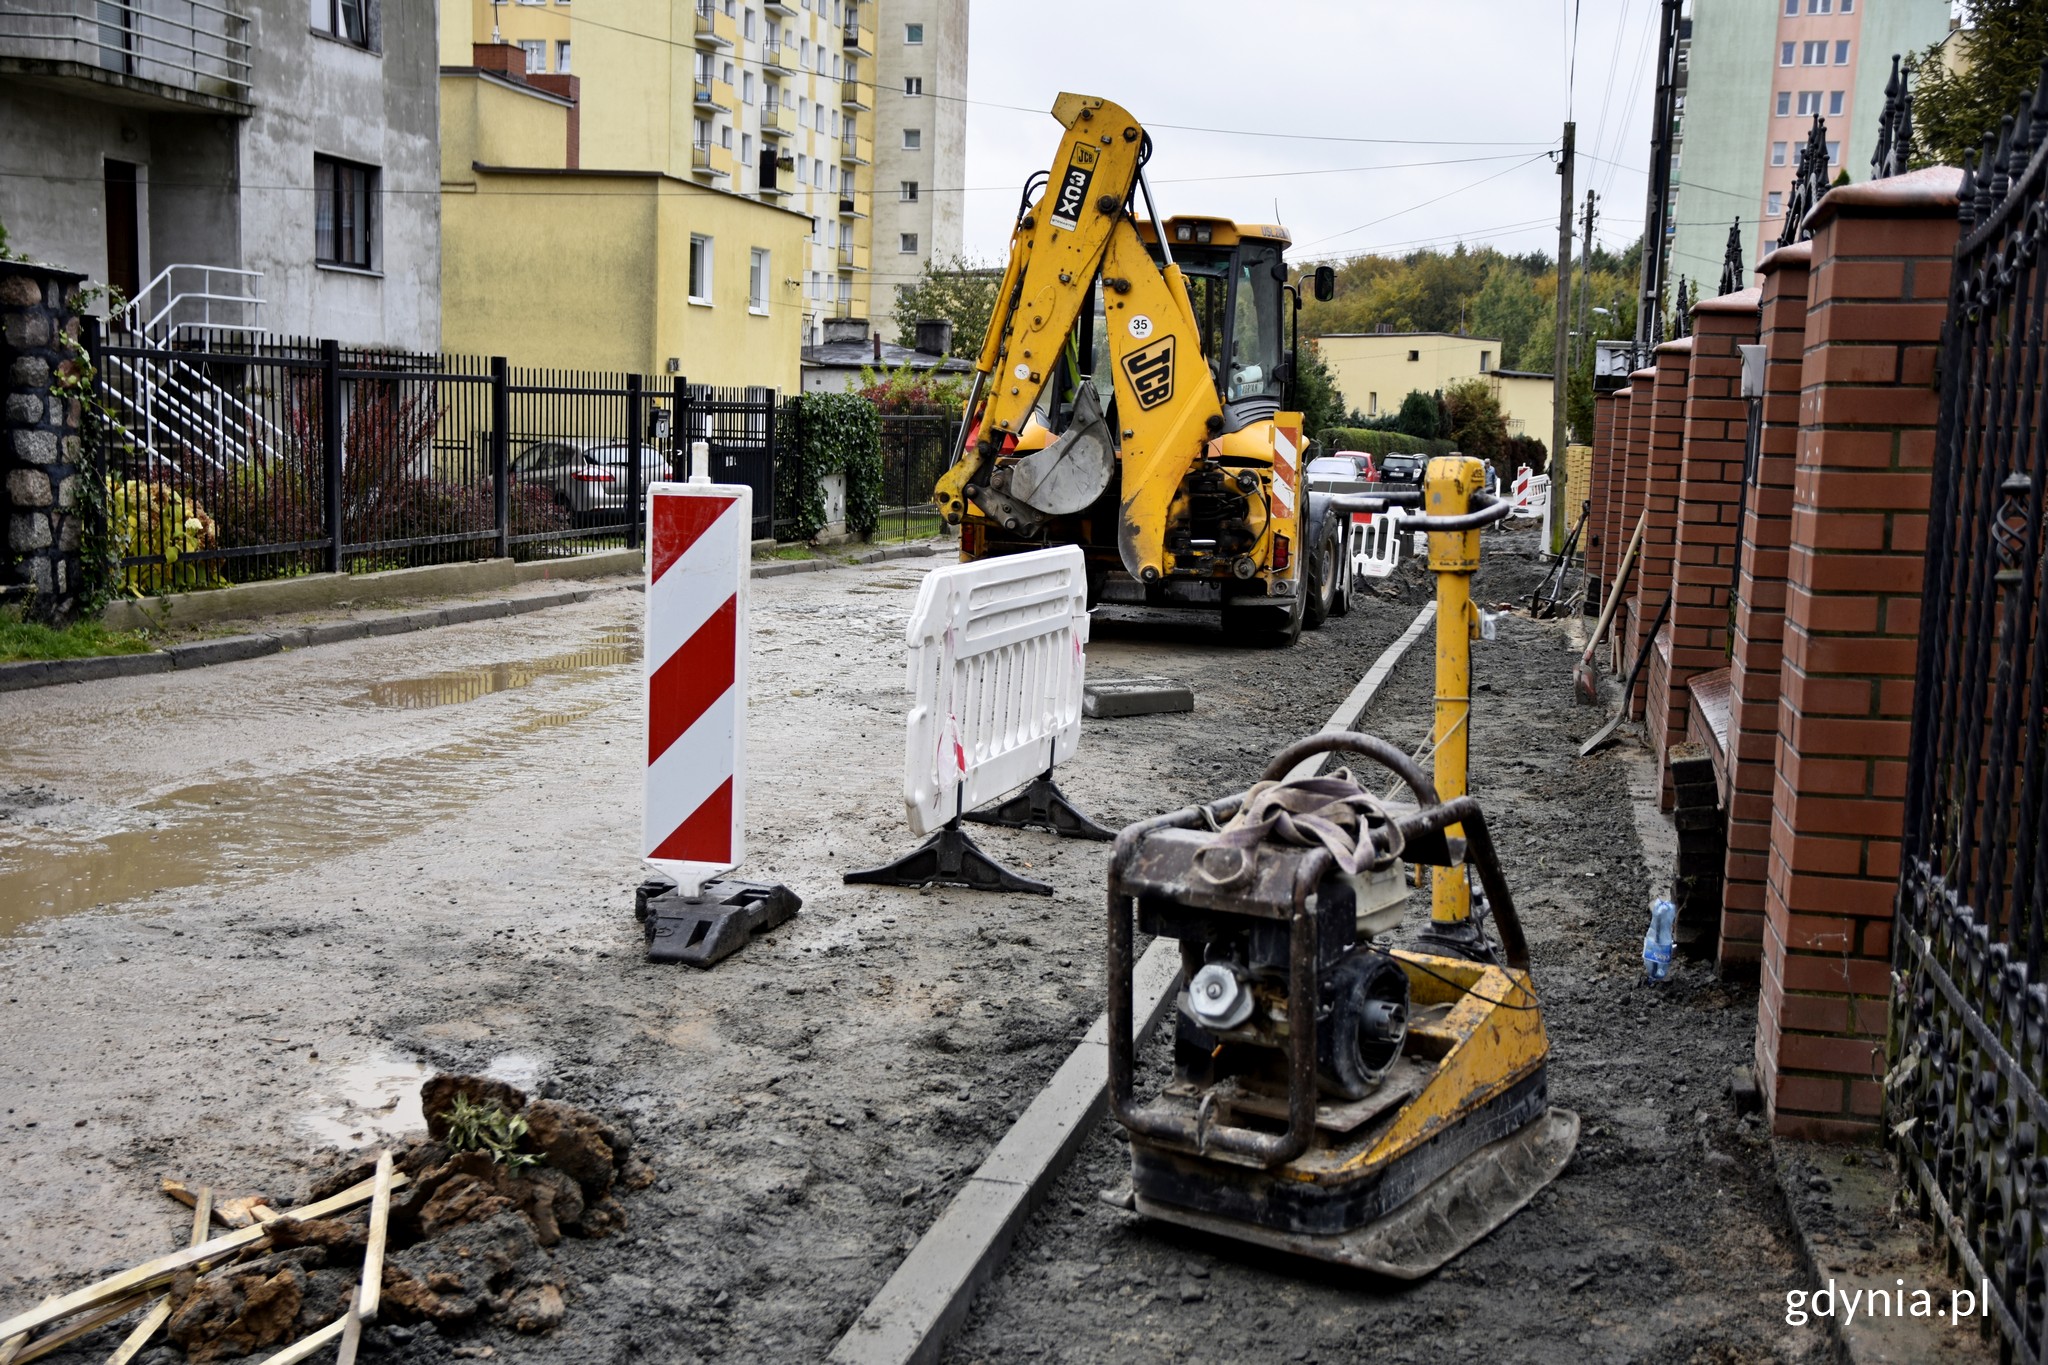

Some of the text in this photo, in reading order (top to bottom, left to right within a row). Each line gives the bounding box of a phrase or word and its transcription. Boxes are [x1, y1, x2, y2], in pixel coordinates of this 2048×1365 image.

[1078, 149, 1093, 163] JCB
[1058, 171, 1086, 216] 3CX
[1133, 319, 1148, 330] 35
[1127, 347, 1171, 405] JCB
